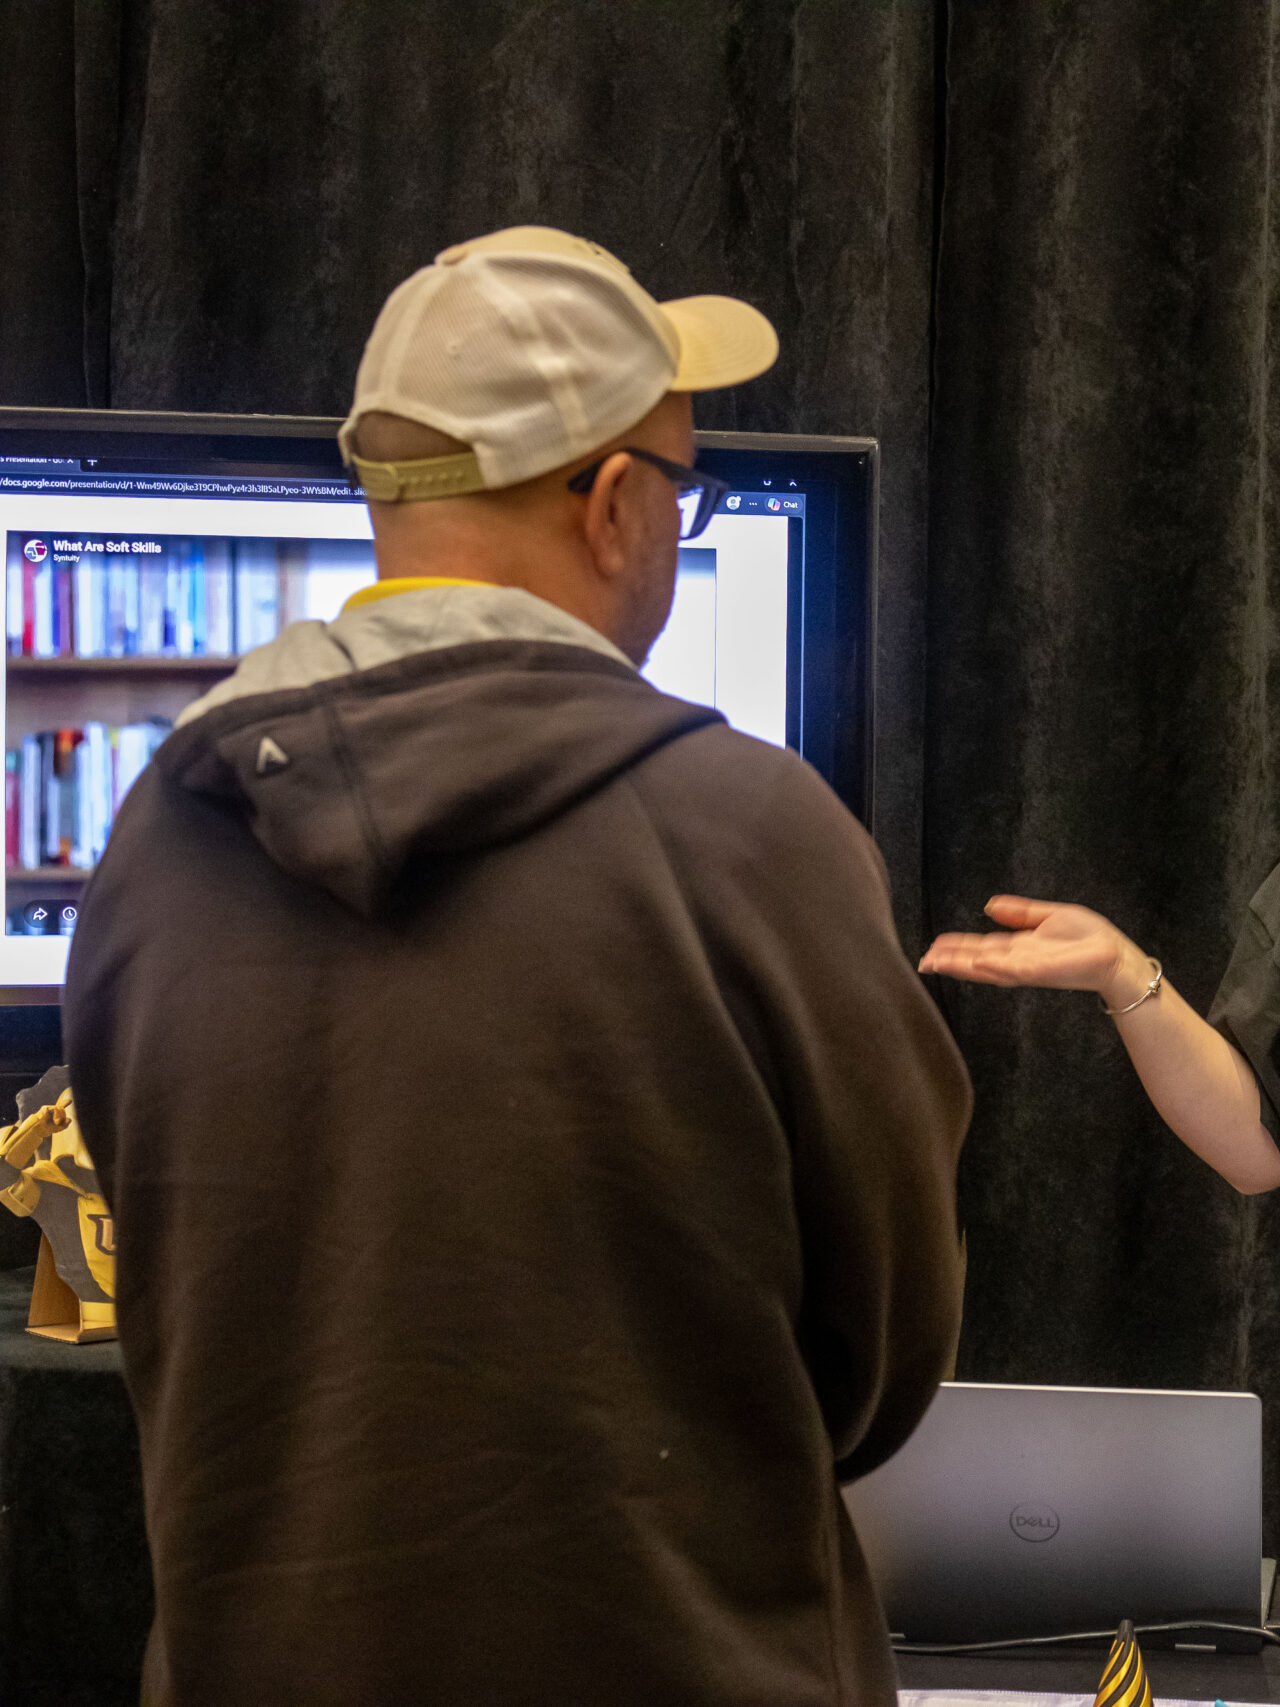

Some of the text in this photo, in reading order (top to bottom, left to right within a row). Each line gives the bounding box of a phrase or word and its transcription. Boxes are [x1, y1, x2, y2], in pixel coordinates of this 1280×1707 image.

[783, 501, 798, 509] Chat
[53, 540, 162, 553] What Are Soft Skills
[1016, 1516, 1056, 1528] DELL
